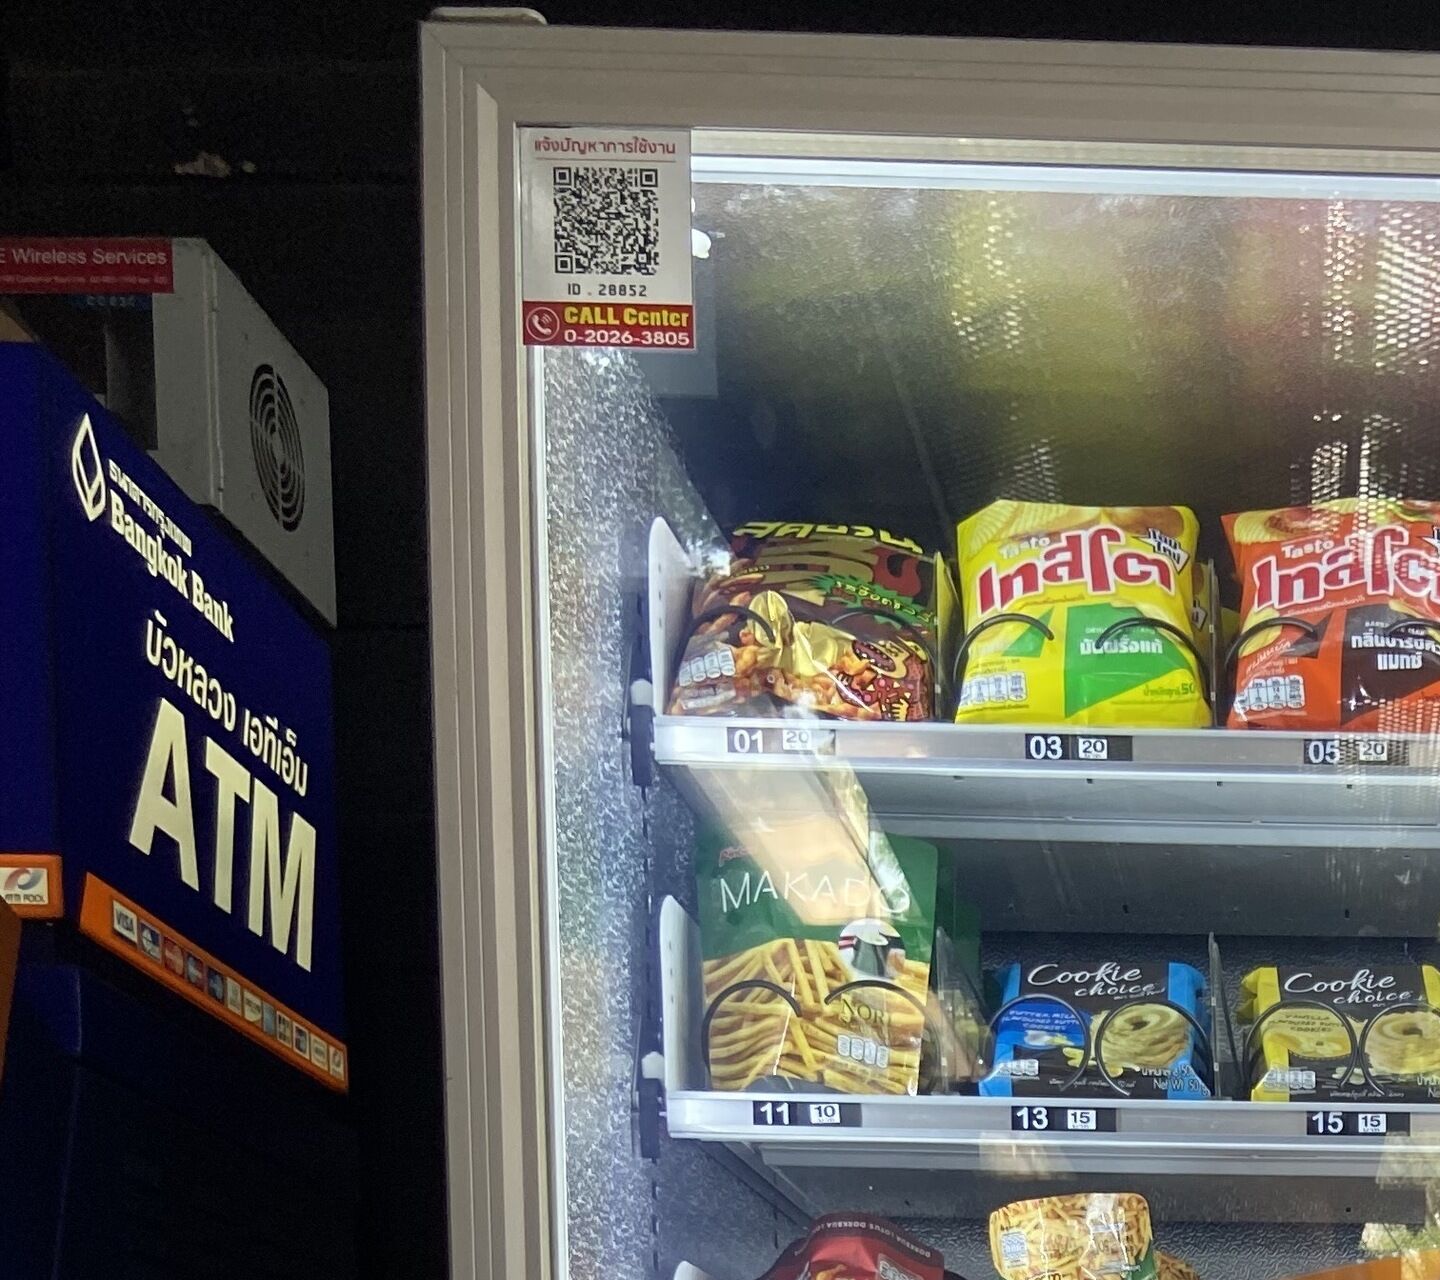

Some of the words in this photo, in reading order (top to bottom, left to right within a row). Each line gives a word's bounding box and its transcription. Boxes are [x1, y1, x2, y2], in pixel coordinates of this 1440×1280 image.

[535, 136, 676, 155] แจ้งปัญหาการใช้งาน
[13, 249, 87, 264] Wireless
[92, 249, 167, 265] Services
[567, 283, 581, 296] ID
[598, 284, 647, 297] 28852
[564, 307, 620, 325] CALL
[623, 308, 690, 327] Center
[564, 329, 690, 346] 0-2026-3805
[110, 489, 190, 599] Bangkok
[191, 570, 234, 643] Bank
[977, 525, 1175, 615] เทสโต
[146, 610, 236, 731] บัวหลวง
[733, 730, 763, 752] 01
[1030, 737, 1062, 759] 03
[1082, 740, 1105, 753] 20
[129, 697, 316, 972] ATM
[1027, 962, 1143, 986] Cookie
[1284, 969, 1396, 994] Cookie
[1075, 981, 1157, 997] choice
[1333, 989, 1411, 1005] choice
[760, 1103, 790, 1125] 11
[813, 1106, 835, 1118] 10
[1016, 1107, 1049, 1130] 13
[1071, 1112, 1090, 1124] 15
